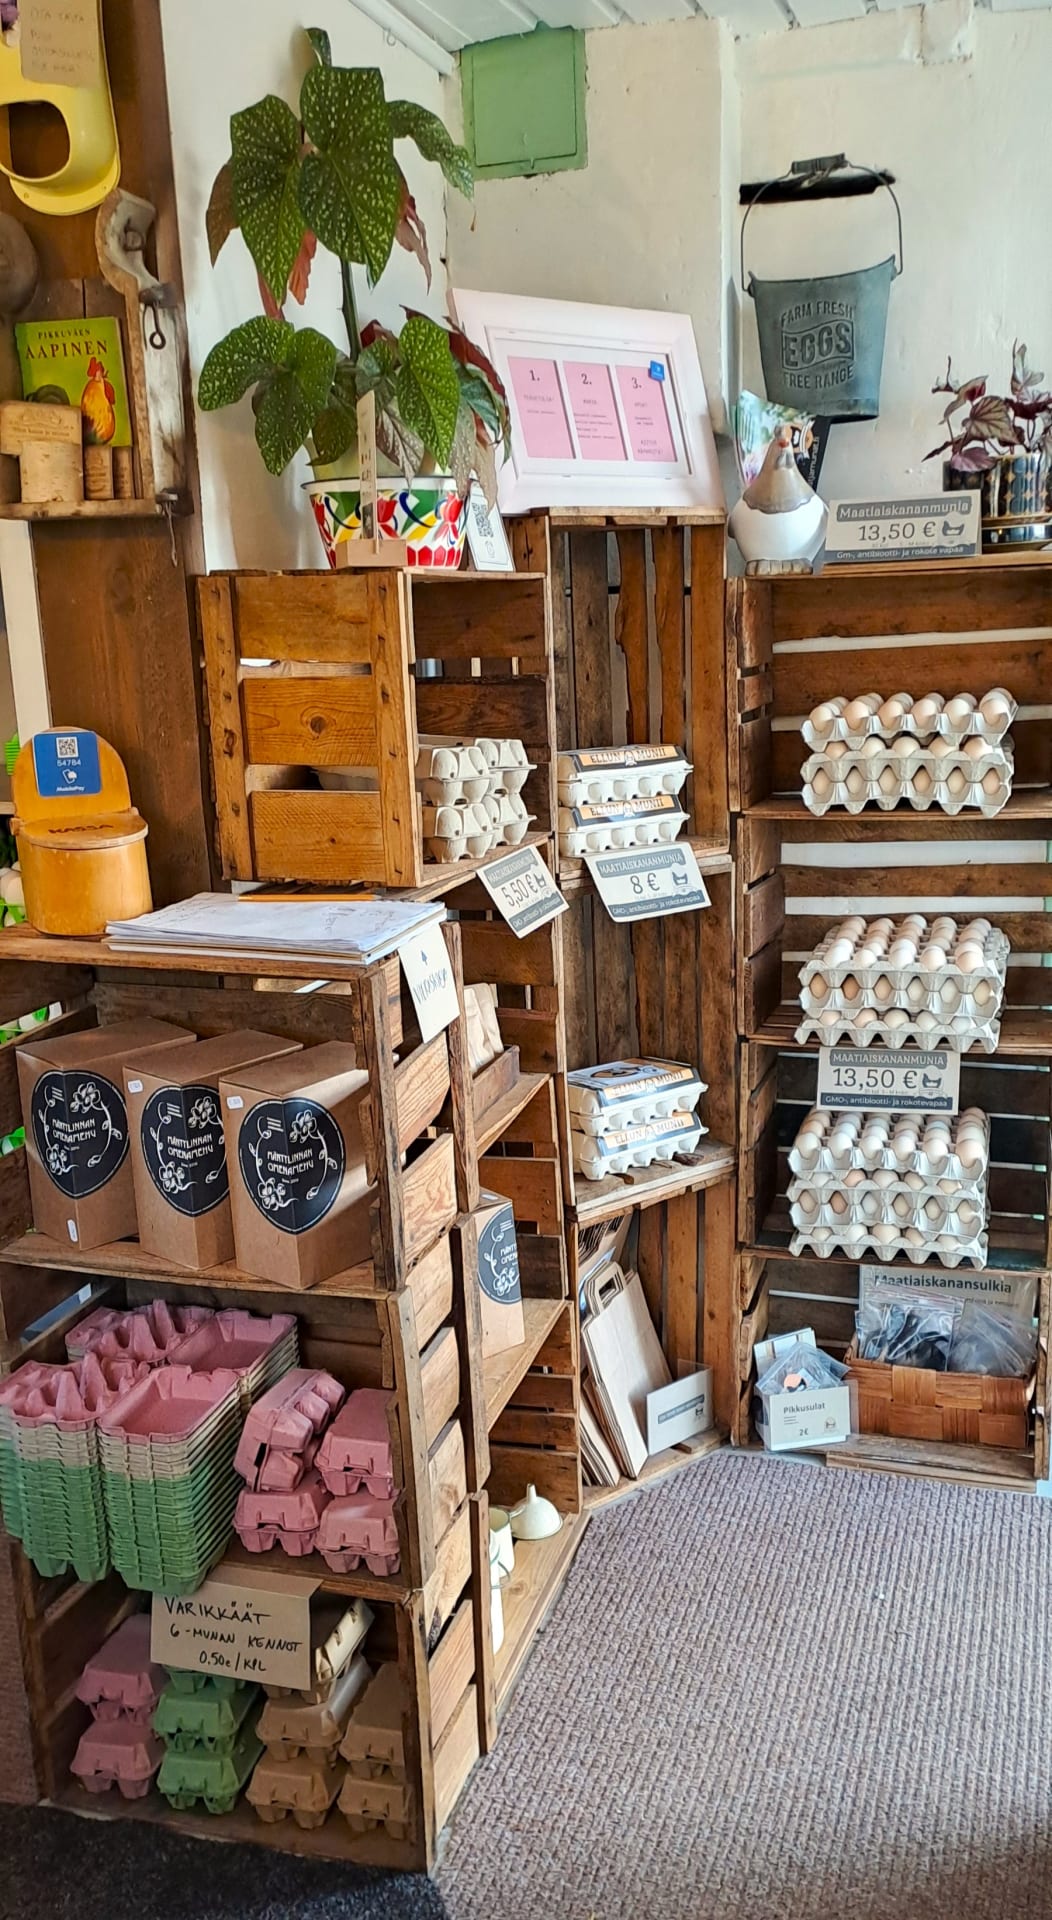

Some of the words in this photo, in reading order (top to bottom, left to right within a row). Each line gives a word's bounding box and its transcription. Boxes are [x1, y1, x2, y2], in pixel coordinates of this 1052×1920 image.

[781, 302, 812, 327] FARM
[816, 300, 854, 319] FRESH
[26, 340, 107, 359] AAPINEN
[784, 322, 851, 367] EGGS
[529, 369, 540, 381] 1.
[581, 373, 592, 385] 2.
[631, 377, 642, 389] 3.
[783, 372, 812, 389] FREE
[815, 363, 854, 389] RANGE
[839, 500, 970, 519] Maatiaiskananmunia
[858, 522, 916, 543] 13,50
[923, 521, 936, 538] €
[590, 751, 621, 764] ELLUN
[590, 803, 621, 816] ELLUN
[600, 853, 684, 874] MAATIAISKANANMUNIA
[500, 878, 530, 908] 5,50
[524, 873, 539, 894] €
[630, 875, 644, 895] 8
[647, 872, 660, 891] €
[832, 1052, 945, 1066] MAATIAISKANANMUNIA
[832, 1067, 896, 1091] 13,50
[903, 1070, 918, 1089] €
[849, 1096, 892, 1105] antibiootti-
[892, 1097, 900, 1106] ja
[900, 1098, 948, 1108] rokotevapaa
[874, 1275, 1012, 1294] Maatiaiskanansulkia
[783, 1402, 826, 1414] Pikkusulat
[164, 1597, 272, 1625] VARIKKÄÄT
[247, 1635, 303, 1653] KENNOT
